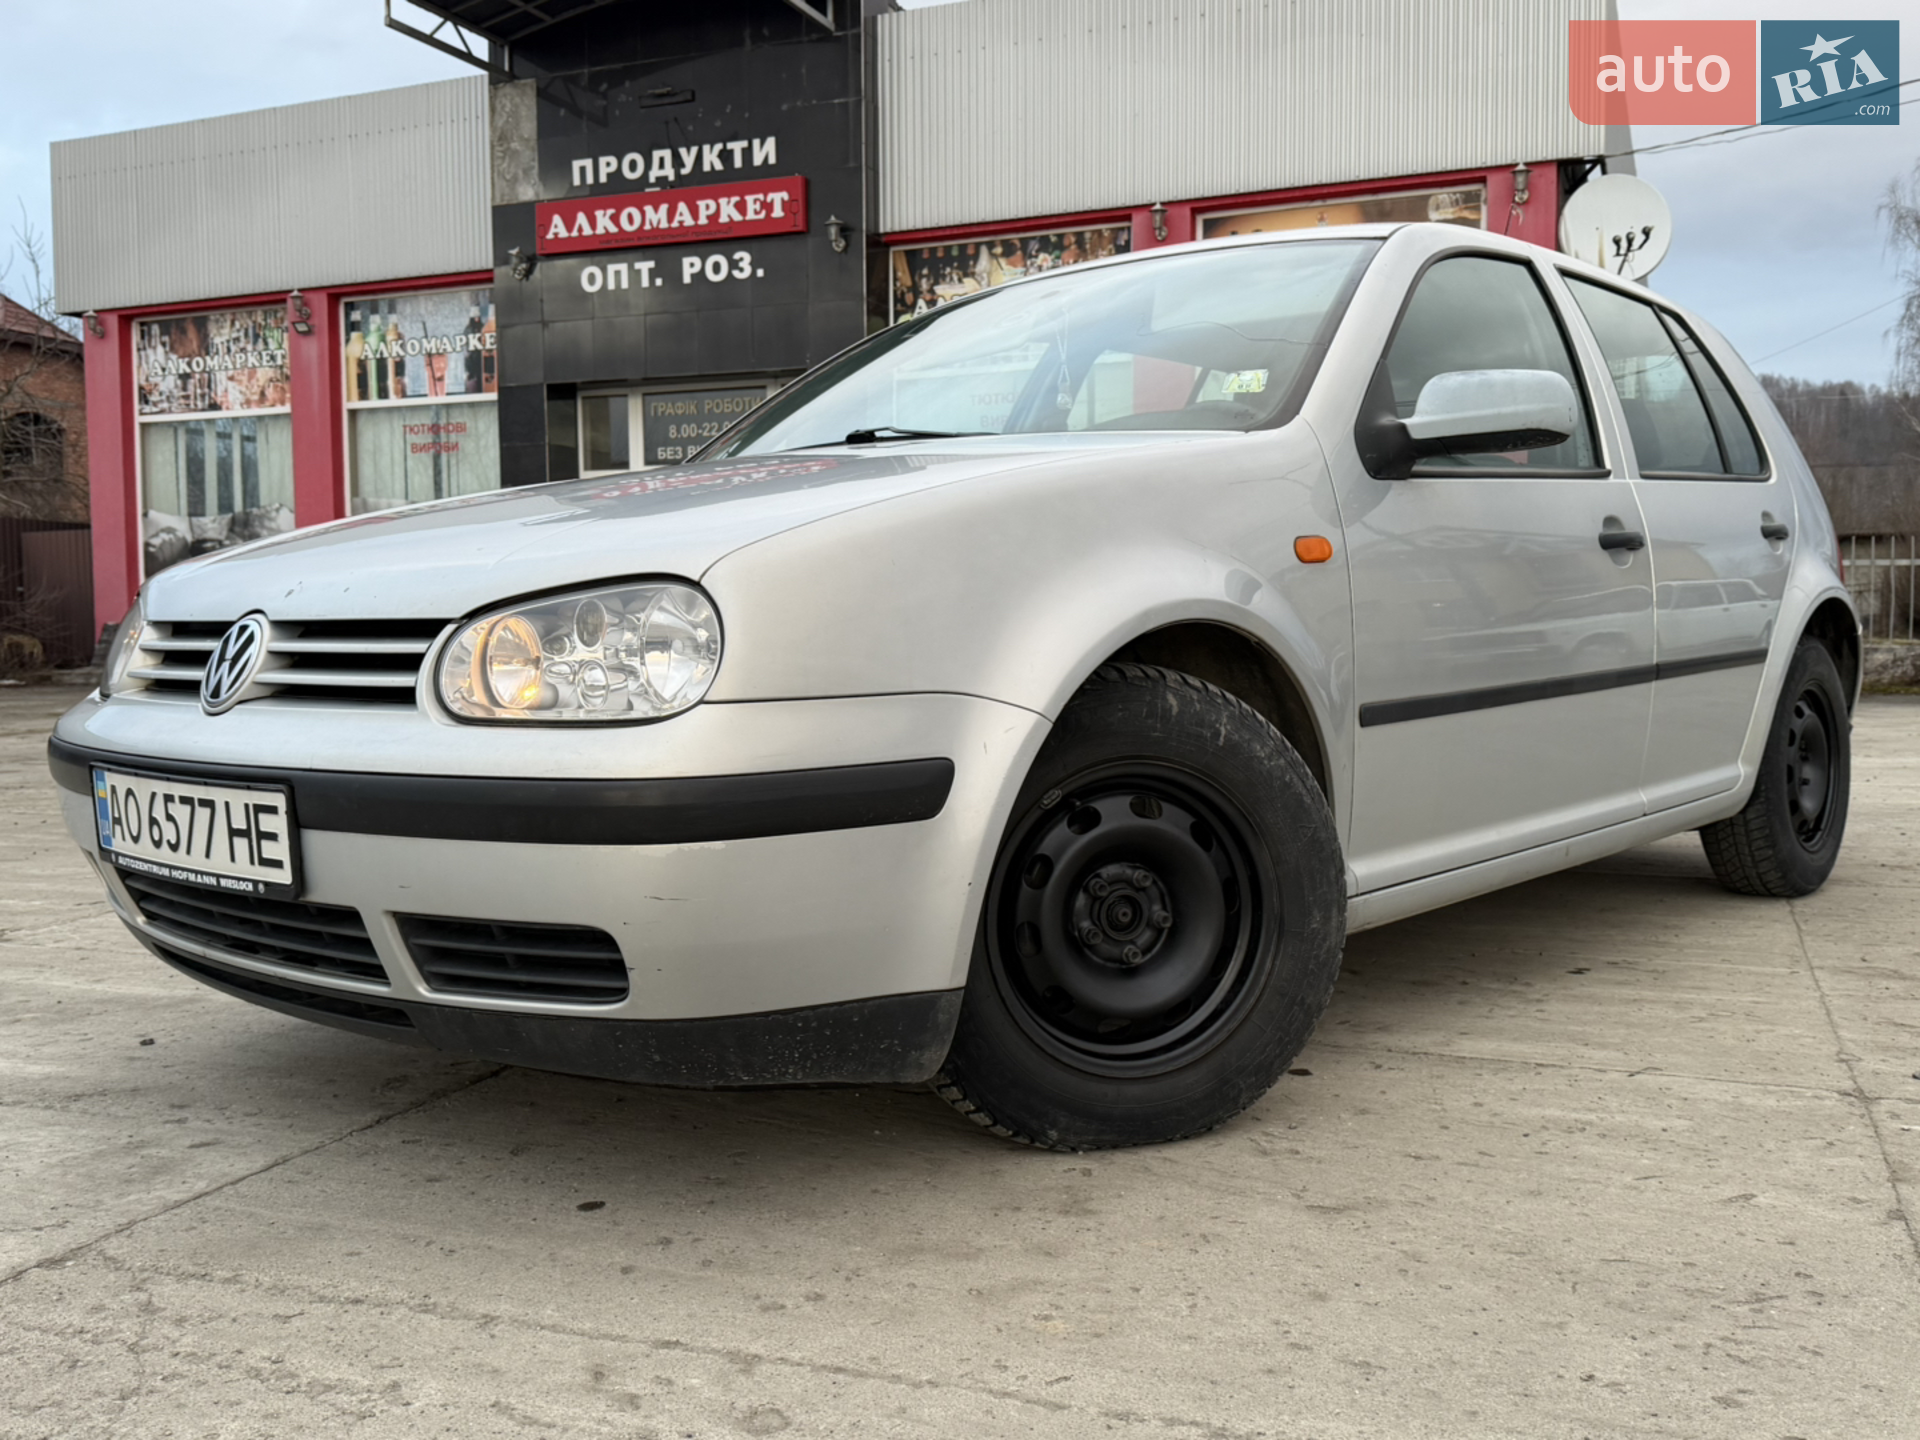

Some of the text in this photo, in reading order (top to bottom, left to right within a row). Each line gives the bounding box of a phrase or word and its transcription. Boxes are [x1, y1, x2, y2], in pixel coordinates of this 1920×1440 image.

[571, 136, 777, 187] ПРОДУКТИ
[545, 191, 790, 239] АЛКОМАРКЕТ
[580, 251, 765, 293] ОПТ. РОЗ.
[360, 332, 498, 360] АЛКОМАРКЕ
[150, 349, 286, 377] АЛКОМАРКЕТ
[650, 401, 698, 417] ГРАФІК
[402, 422, 467, 436] ТЮТЮНОВІ
[411, 442, 460, 455] ВИРОБИ
[657, 446, 683, 460] БЕЗ
[149, 791, 216, 859] 6577
[118, 856, 254, 892] AUTOZENTRUM HOFMANN WIESLOCH
